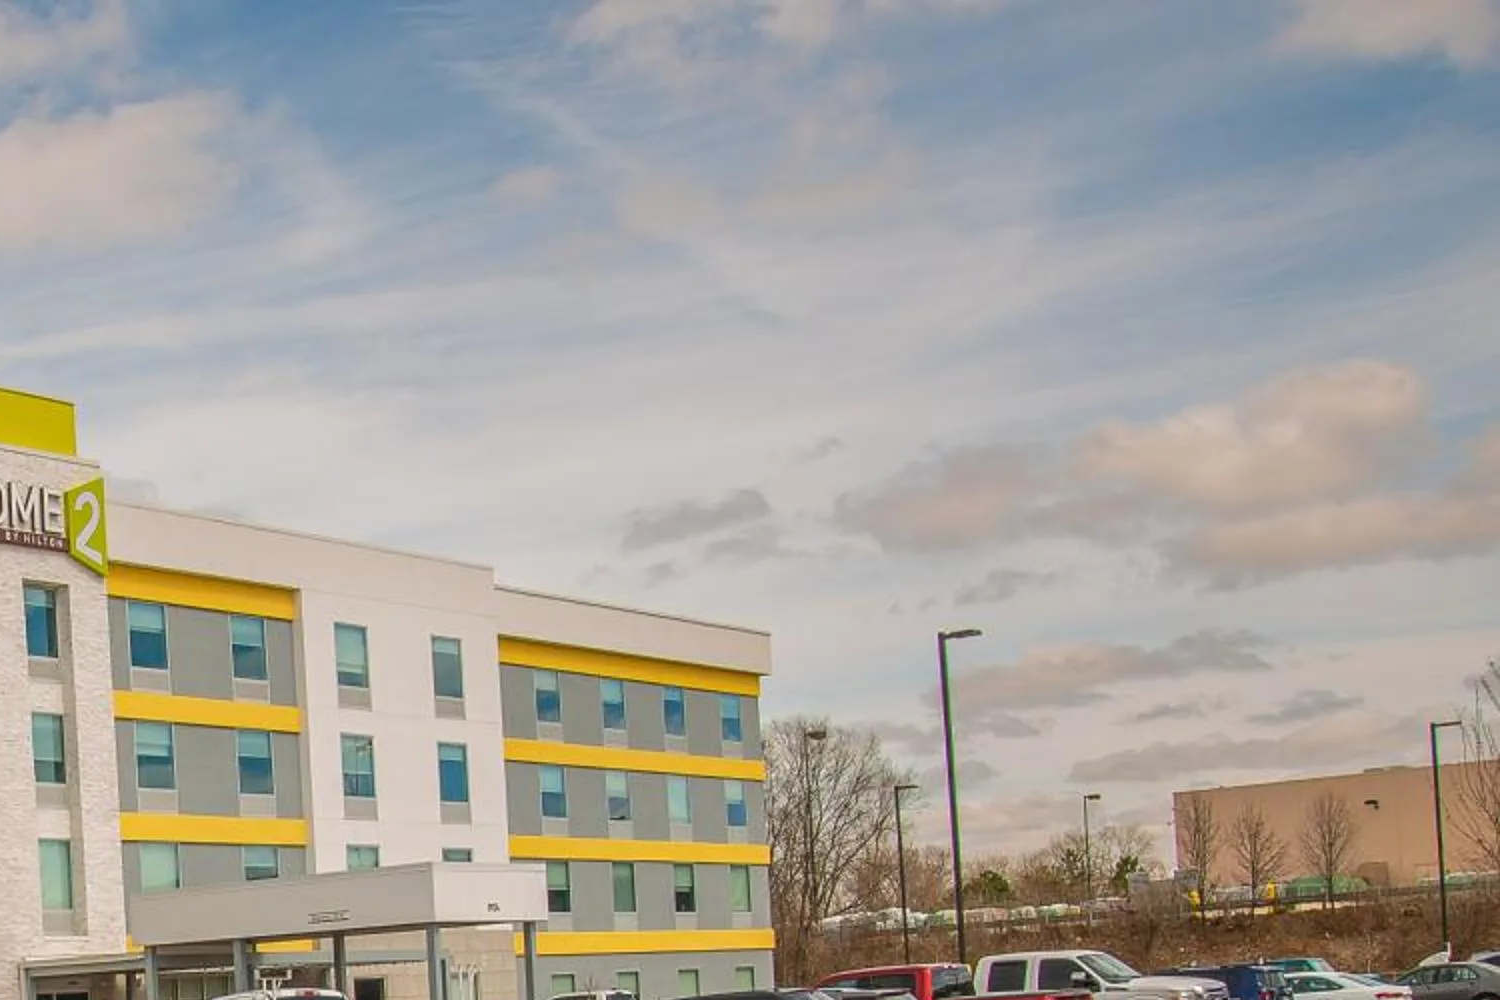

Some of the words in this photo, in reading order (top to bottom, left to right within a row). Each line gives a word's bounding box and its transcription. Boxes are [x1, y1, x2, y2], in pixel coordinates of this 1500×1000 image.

[5, 530, 19, 542] BY
[23, 533, 64, 548] HILTON
[74, 491, 103, 565] 2
